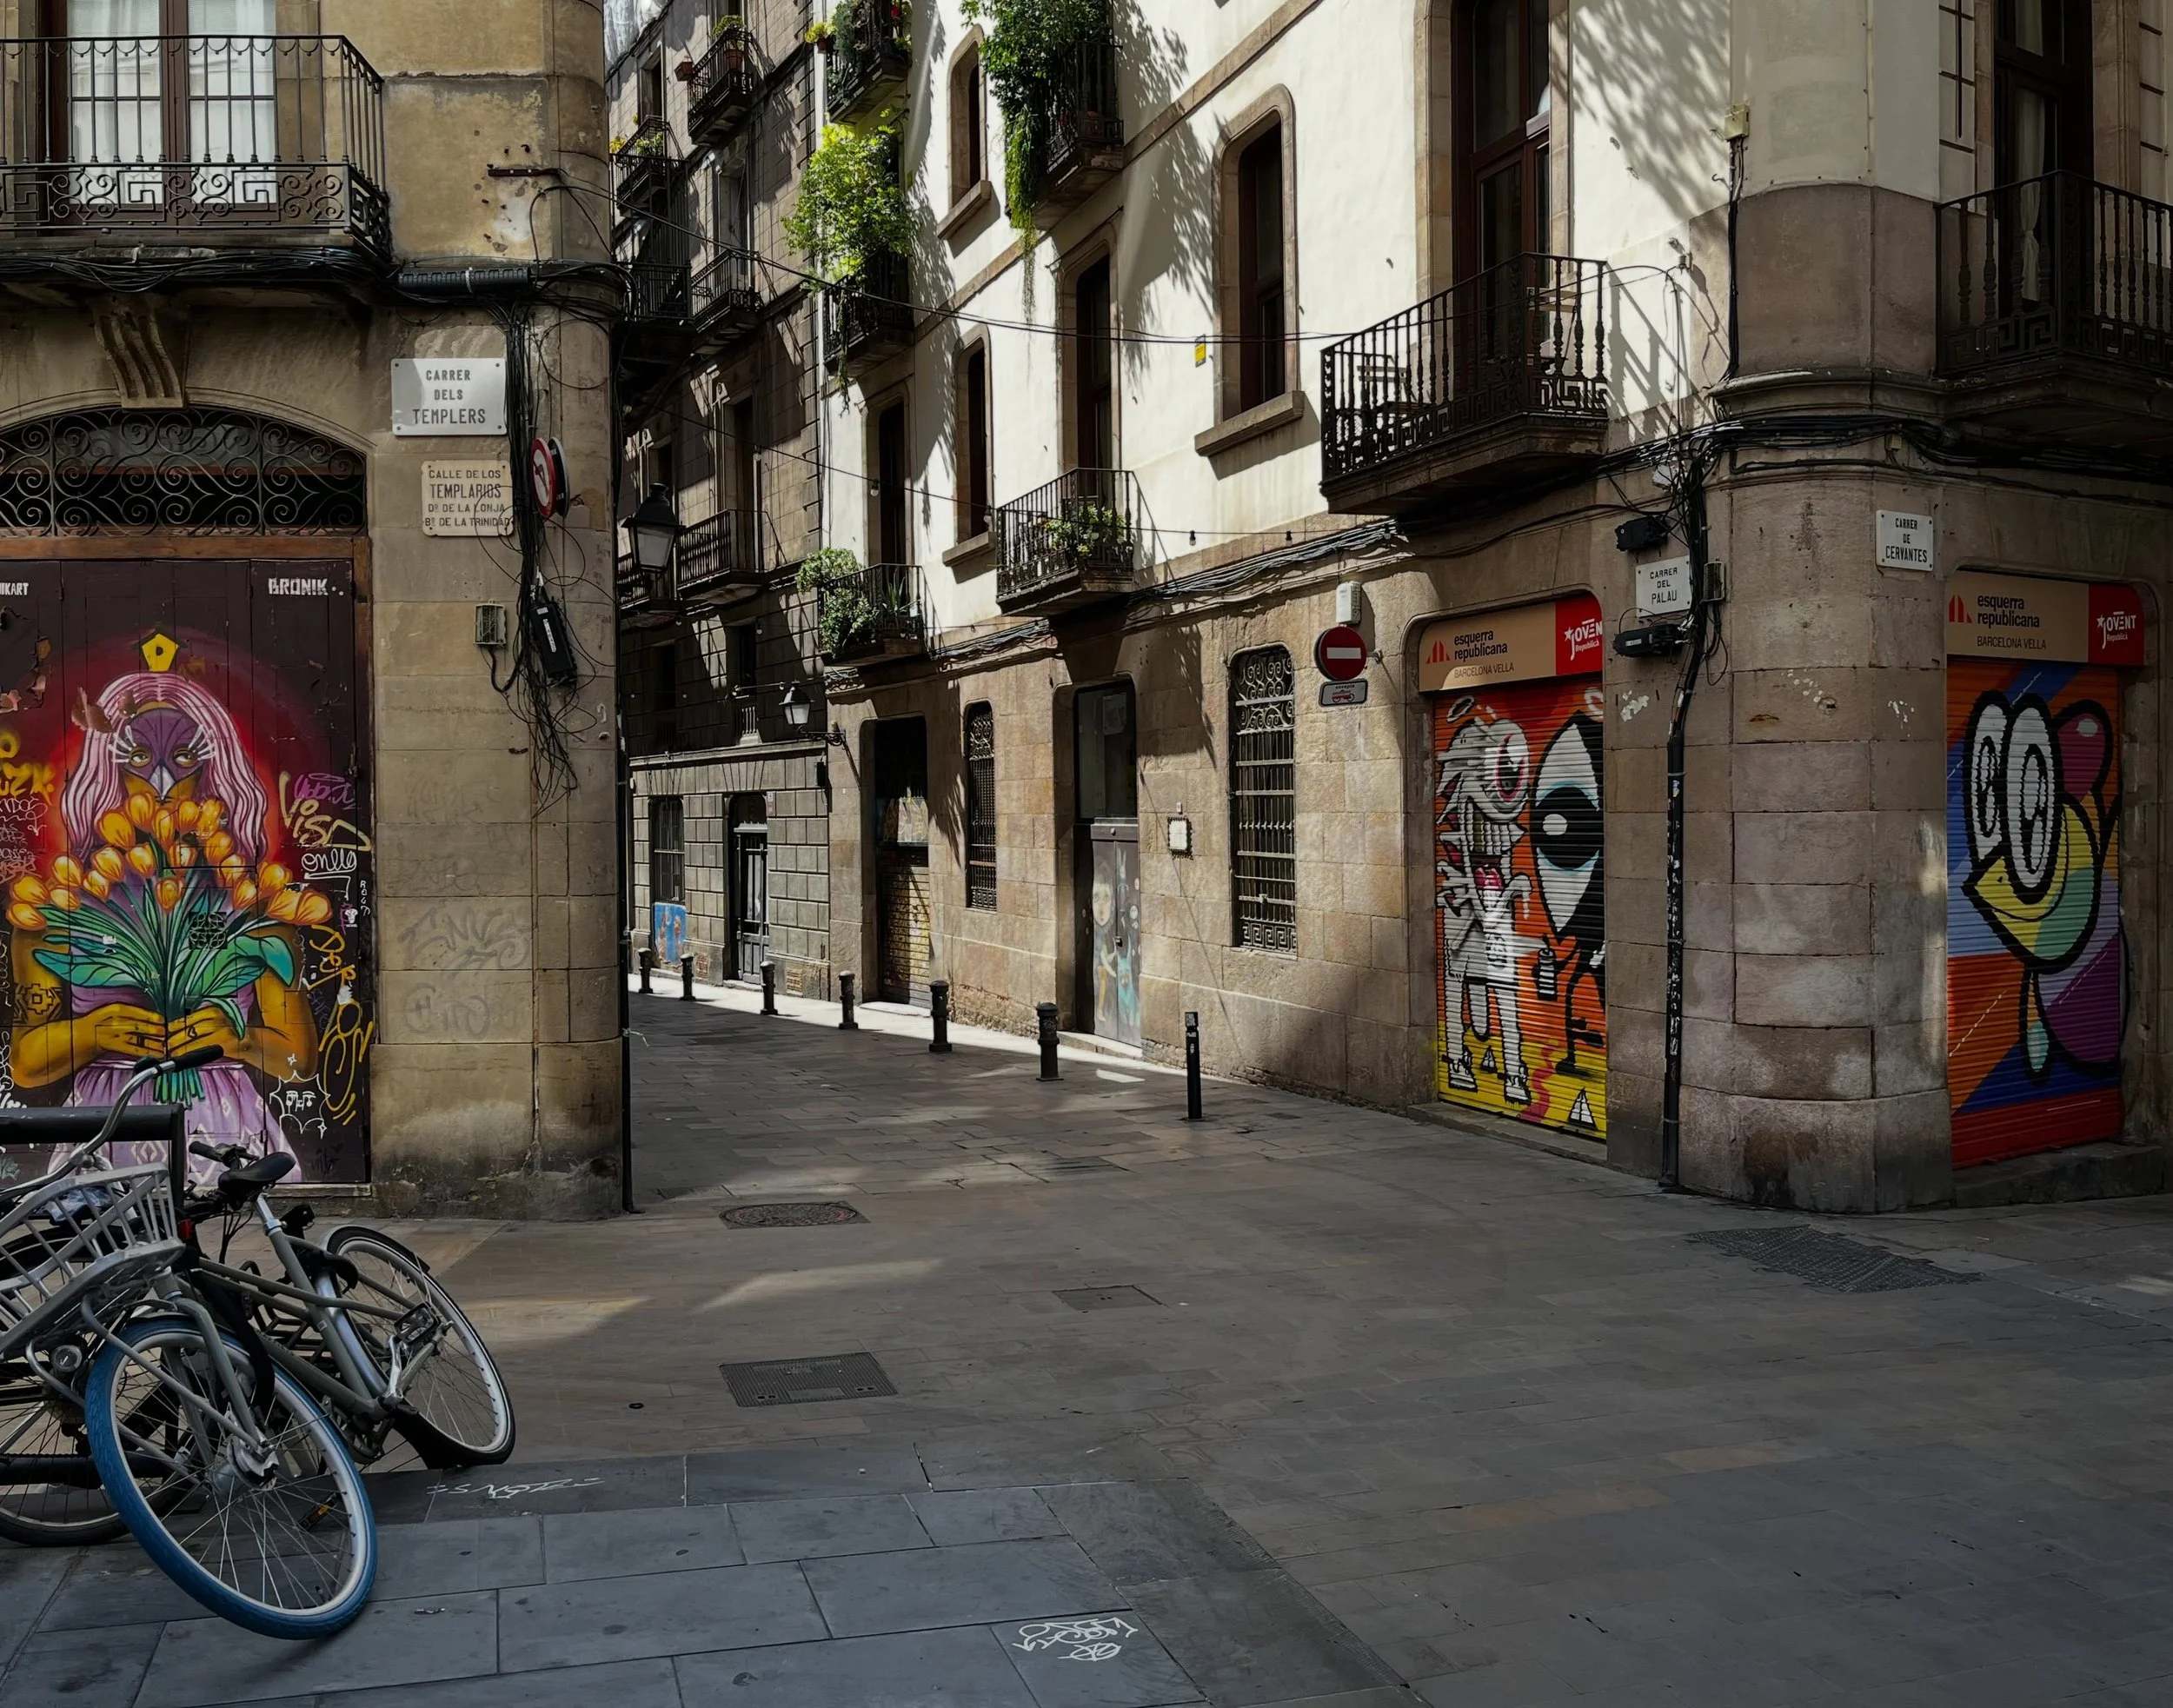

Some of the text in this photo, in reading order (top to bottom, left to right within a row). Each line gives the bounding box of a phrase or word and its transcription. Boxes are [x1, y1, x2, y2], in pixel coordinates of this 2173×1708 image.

[426, 369, 471, 381] CARRER
[434, 389, 463, 401] DELS
[413, 409, 486, 424] TEMPLERS
[429, 469, 502, 479] CALLE DE LOS
[429, 483, 502, 499] TEMPLARIOS
[442, 503, 455, 513] DE
[457, 503, 471, 513] LA
[475, 503, 505, 513] LONJA
[439, 517, 451, 527] DE
[455, 517, 467, 527] LA
[468, 517, 510, 527] TRINIDAD
[1895, 517, 1918, 530] CARRER
[1903, 533, 1911, 544] DE
[1885, 545, 1928, 563] CERVANTES
[1650, 567, 1678, 580] CARRER
[1657, 579, 1671, 588] DEL
[1651, 589, 1678, 605] PALAU
[1977, 595, 2024, 611] esquerra
[1977, 609, 2040, 628] republicana
[1453, 629, 1494, 647] esquerra
[1977, 635, 2047, 650] BARCELONA VELLA
[1454, 642, 1508, 662] republicana
[1454, 661, 1515, 679] BARCELONA VELLA
